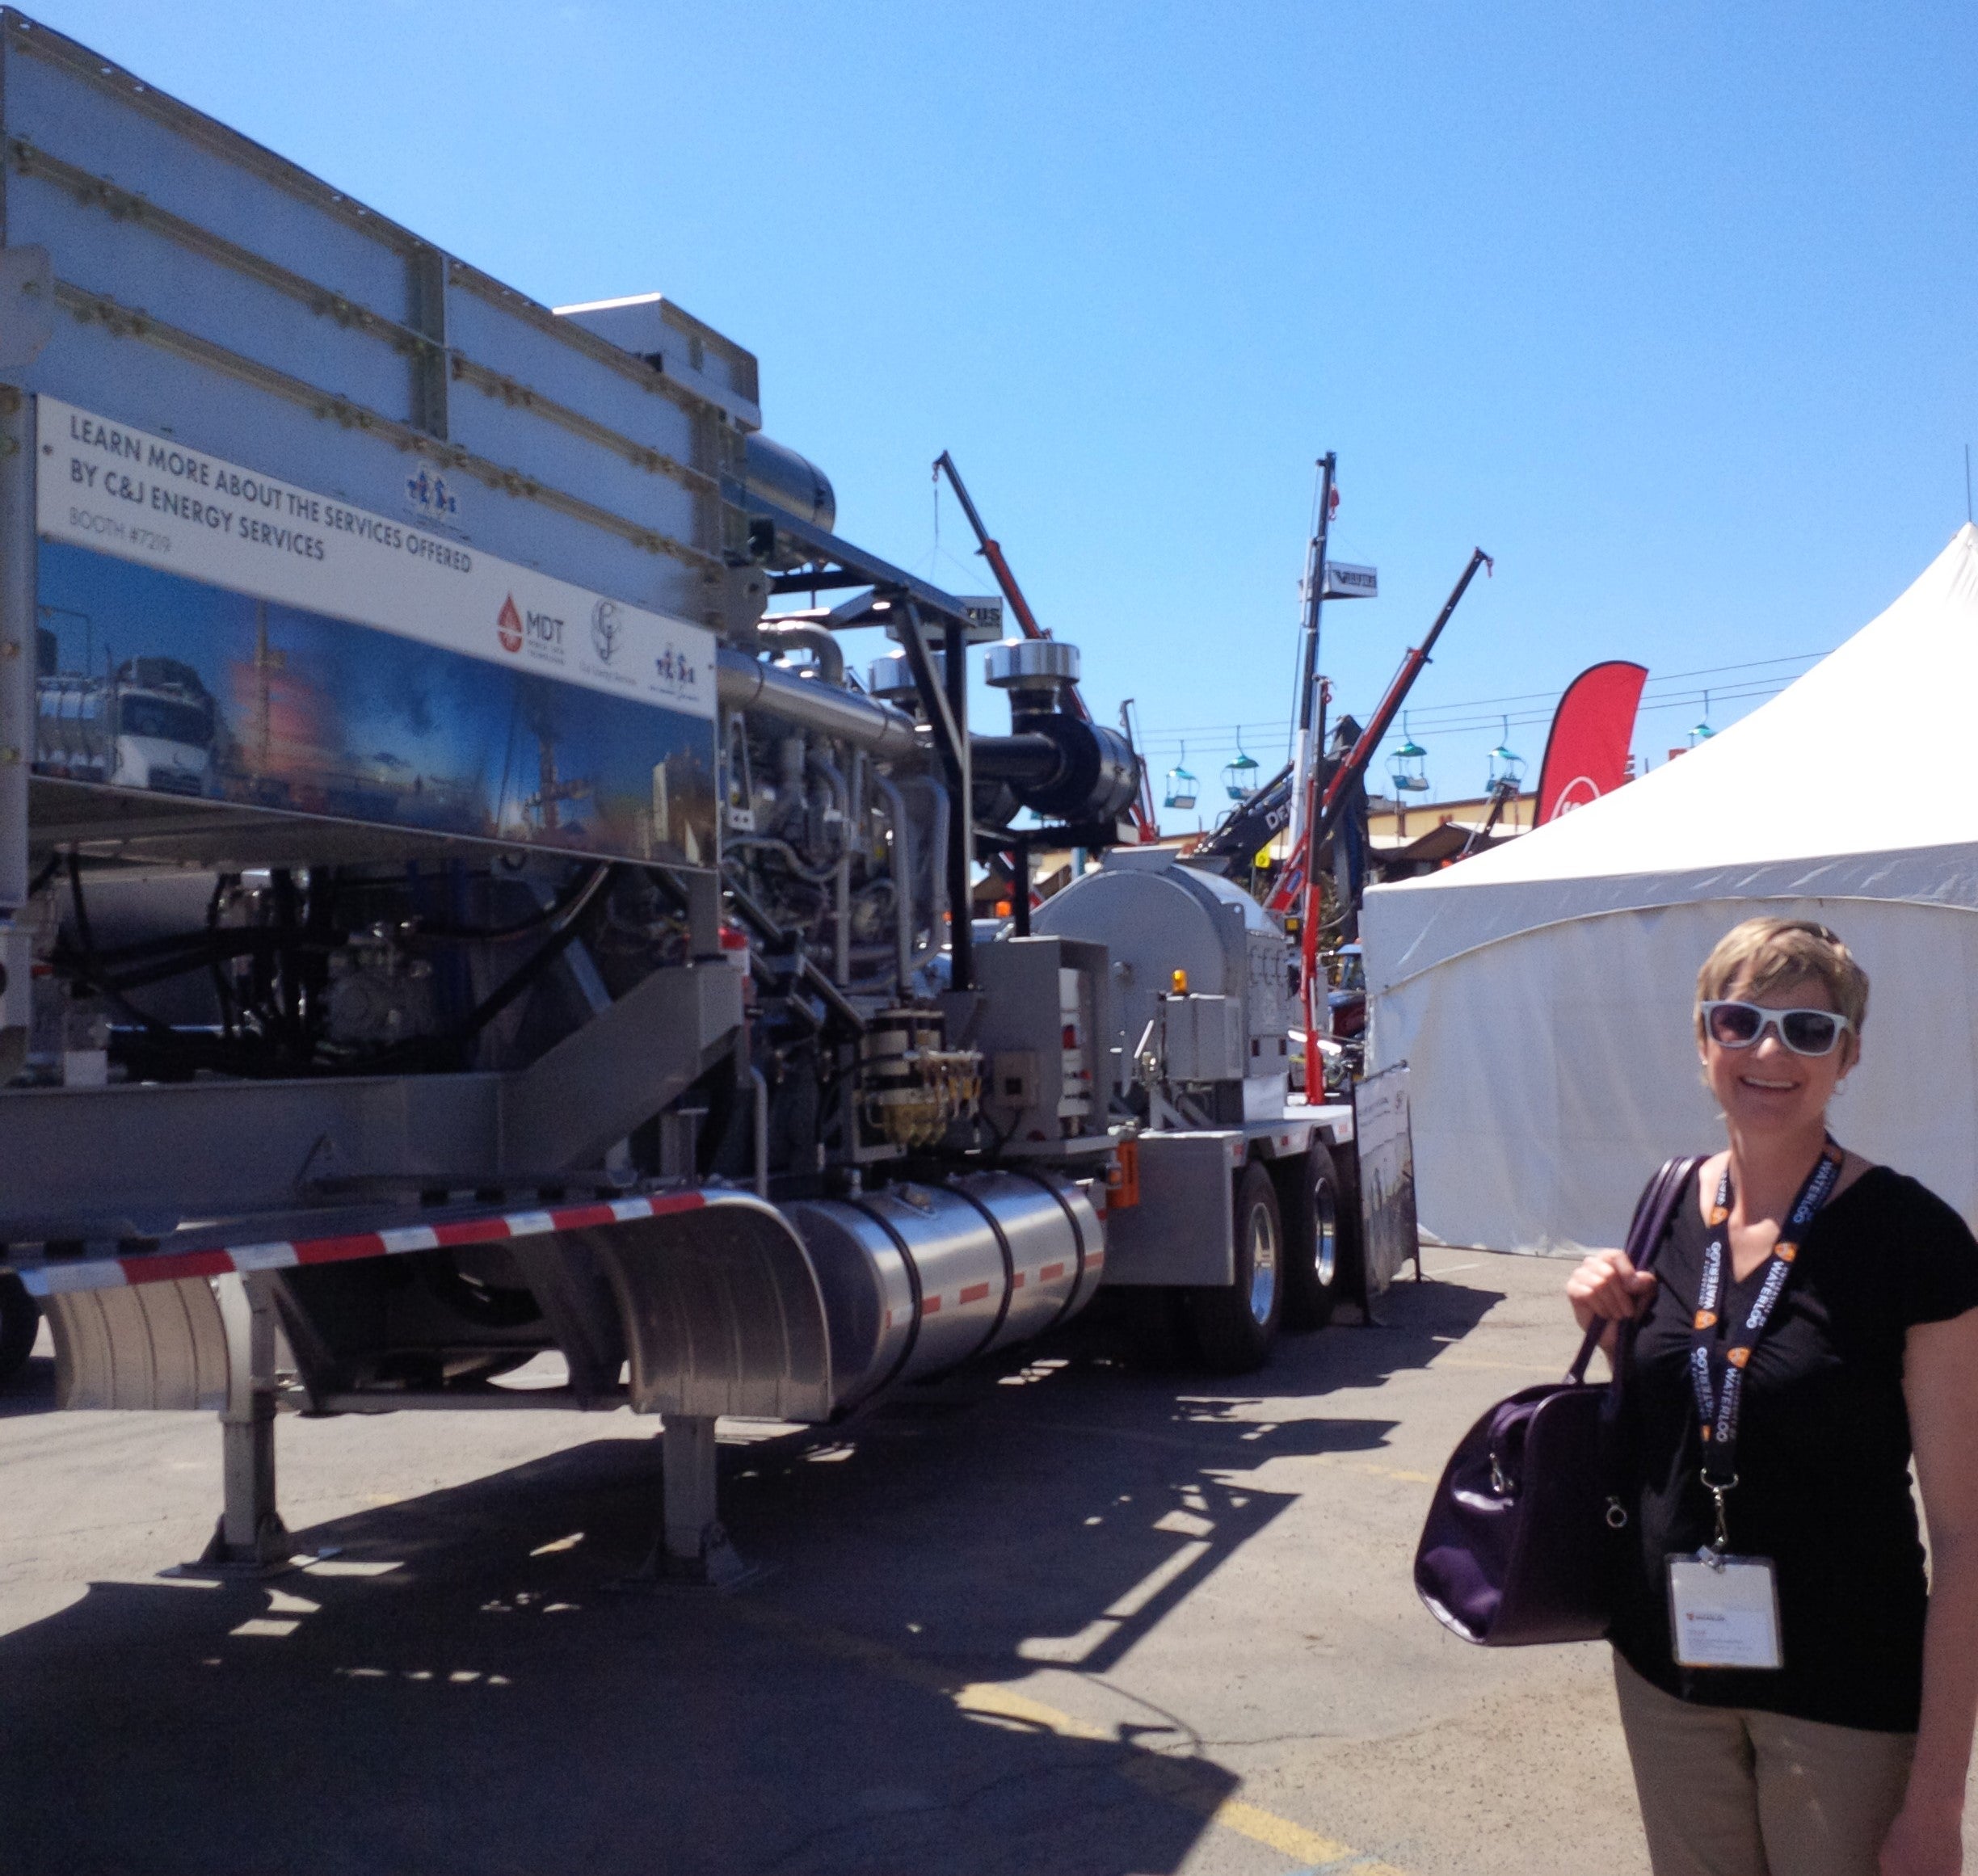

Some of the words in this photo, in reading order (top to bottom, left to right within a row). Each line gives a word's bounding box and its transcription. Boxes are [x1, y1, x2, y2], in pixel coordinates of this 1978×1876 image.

[69, 506, 124, 538] BOOTH
[70, 415, 141, 461] LEARN
[148, 444, 209, 486] MORE
[215, 470, 281, 511] ABOUT
[287, 493, 320, 523] THE
[324, 505, 401, 549] SERVICES
[406, 534, 472, 574] OFFERED
[70, 456, 98, 487] BY
[104, 471, 144, 504] C&J
[150, 486, 232, 532] ENERGY
[239, 516, 324, 561] SERVICES
[526, 610, 563, 645] MDT
[1265, 798, 1292, 831] DE
[1793, 1159, 1833, 1224] WATERLOO
[1702, 1241, 1722, 1310] WATERLOO
[1746, 1260, 1785, 1329] WATERLOO
[1715, 1367, 1738, 1443] WATERLOO
